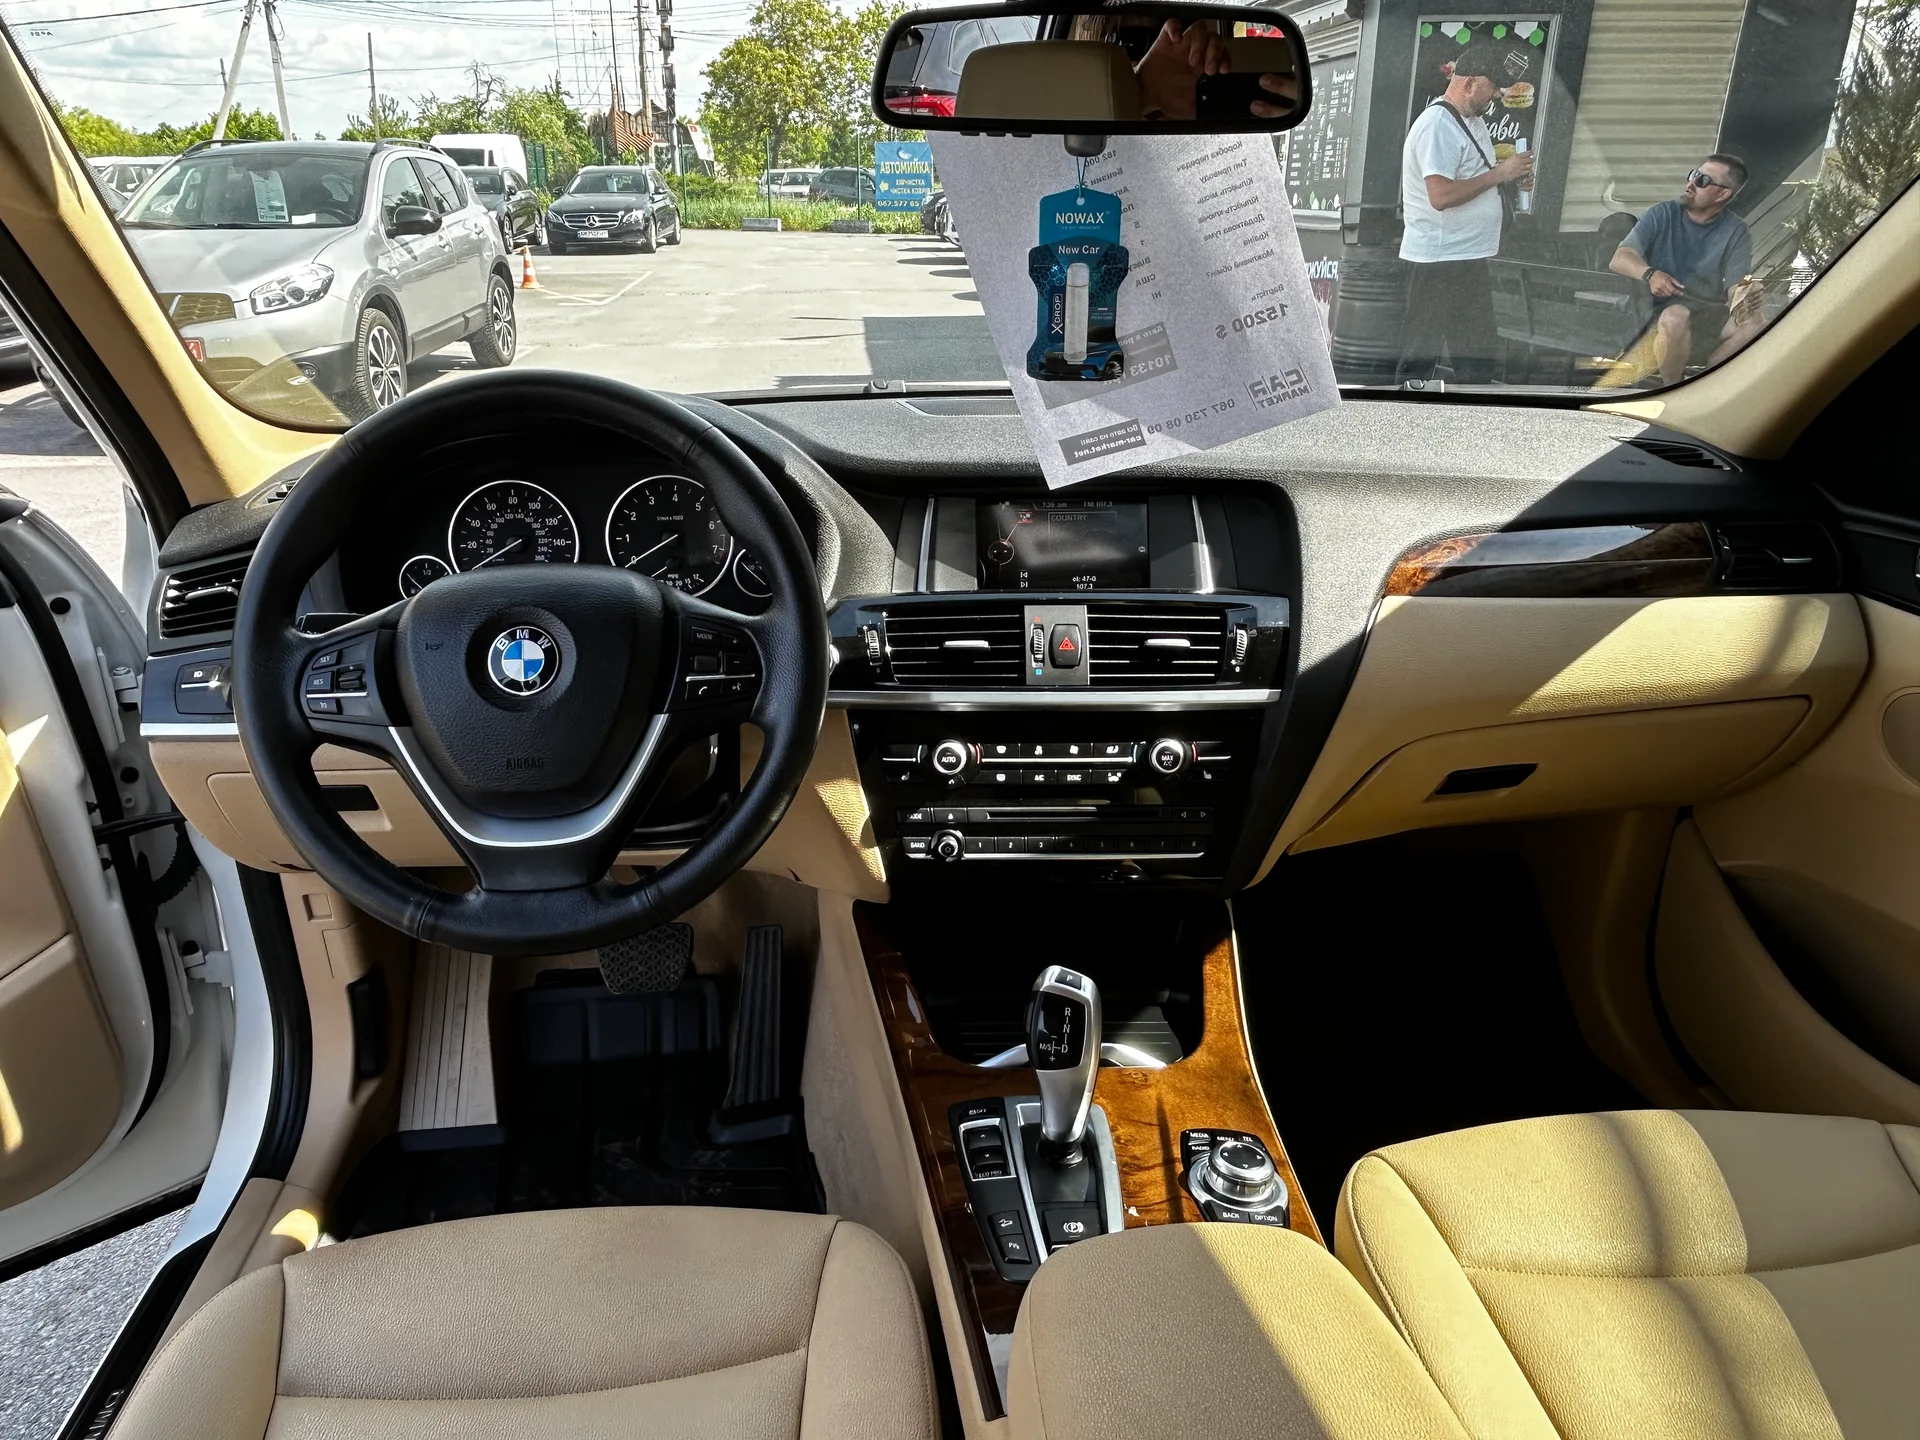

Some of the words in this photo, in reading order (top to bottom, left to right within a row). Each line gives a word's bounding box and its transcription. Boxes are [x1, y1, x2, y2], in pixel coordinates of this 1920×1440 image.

[880, 157, 930, 174] АВТОМИЙКА
[1055, 212, 1105, 225] NOWAX
[1058, 245, 1079, 254] New
[1082, 245, 1100, 254] Car
[1305, 256, 1339, 282] ЖУЙСЯ,
[649, 496, 655, 505] 3
[672, 493, 678, 502] 4
[528, 502, 540, 510] 100
[695, 502, 701, 511] 5
[630, 512, 637, 521] 2
[471, 519, 481, 528] 40
[545, 518, 558, 526] 120
[709, 521, 715, 530] 6
[625, 533, 630, 543] 1
[467, 541, 477, 549] 20
[553, 539, 566, 547] 140
[712, 545, 718, 554] 7
[495, 629, 552, 651] BMW
[1065, 1007, 1071, 1017] R
[1063, 1024, 1071, 1033] N
[1039, 1043, 1052, 1051] M/S
[1061, 1044, 1069, 1053] D
[1255, 1214, 1278, 1222] OPTION
